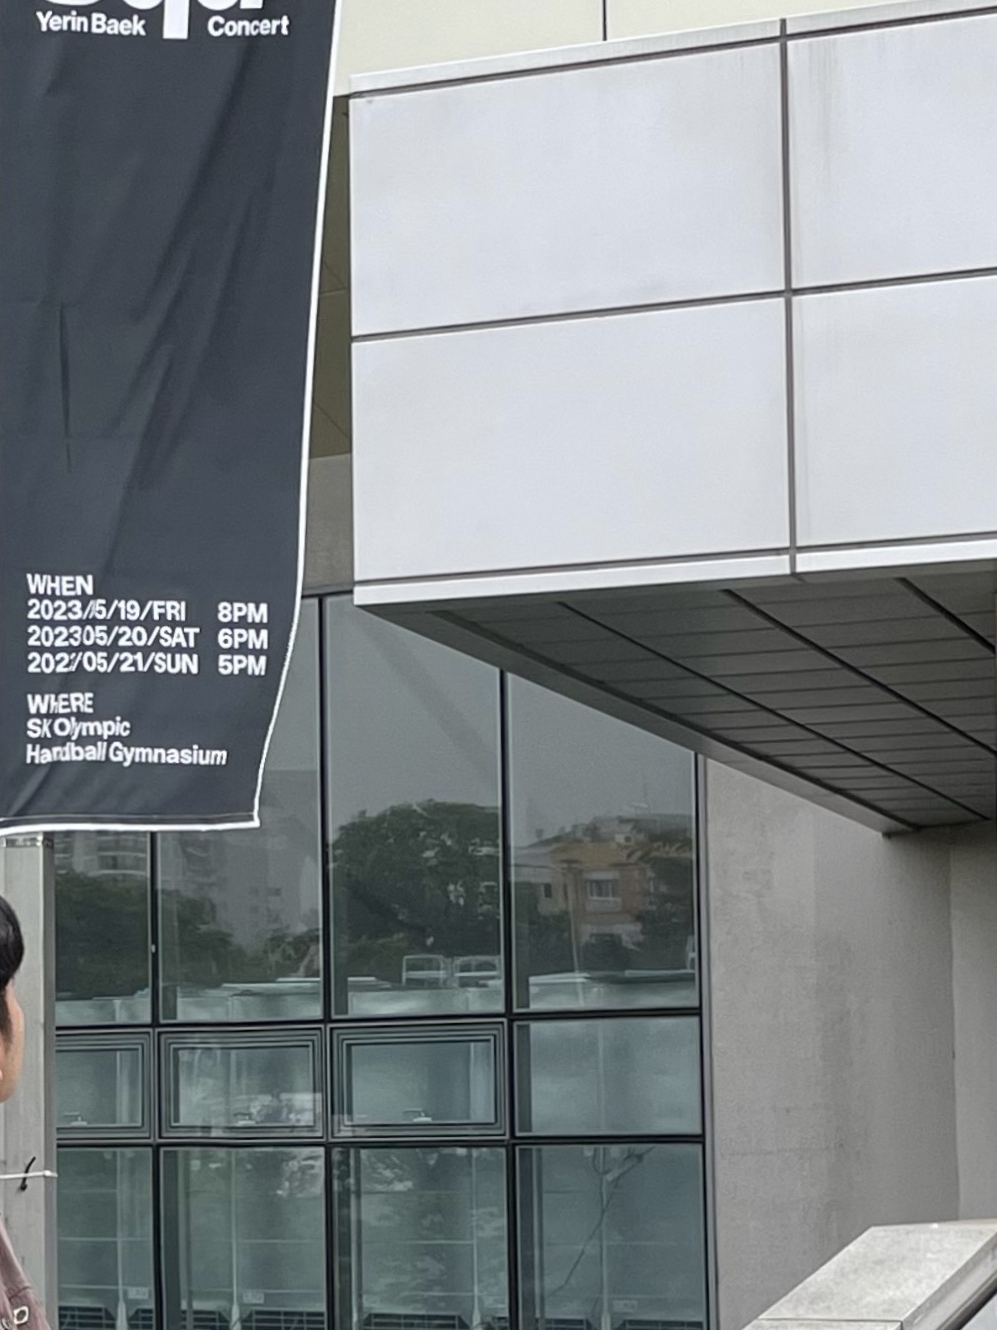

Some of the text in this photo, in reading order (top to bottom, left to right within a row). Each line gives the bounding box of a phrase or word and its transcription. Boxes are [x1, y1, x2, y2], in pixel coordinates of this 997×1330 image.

[35, 10, 88, 33] Yerin
[90, 13, 147, 36] Baek
[207, 15, 290, 37] Concert
[26, 573, 94, 597] WHEN
[26, 598, 268, 624] 2023/5/19/FRI 8PM
[217, 627, 269, 650] 6PM
[217, 654, 267, 676] 5PM
[26, 691, 94, 715] WHERE
[26, 715, 131, 741] SK Olympic
[108, 741, 229, 768] Gymnasium
